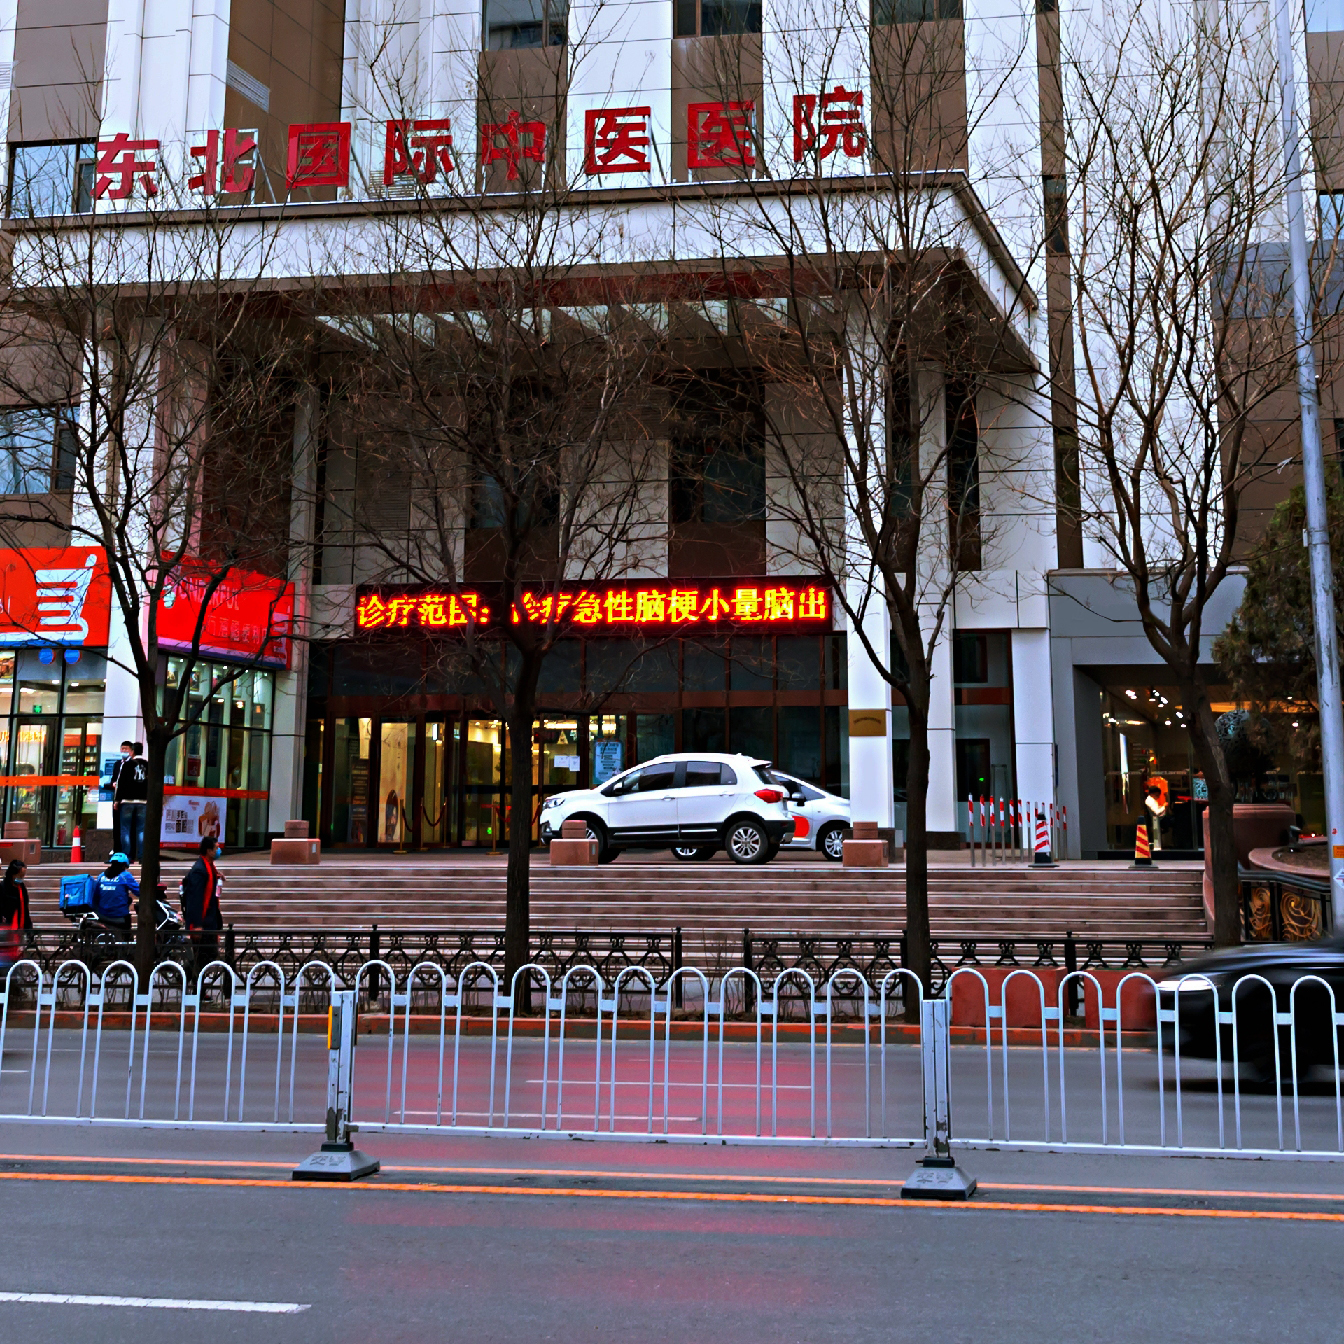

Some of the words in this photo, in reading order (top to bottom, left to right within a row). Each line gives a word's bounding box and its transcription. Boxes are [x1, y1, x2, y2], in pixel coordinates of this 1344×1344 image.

[90, 85, 870, 201] 东北国际中医医院
